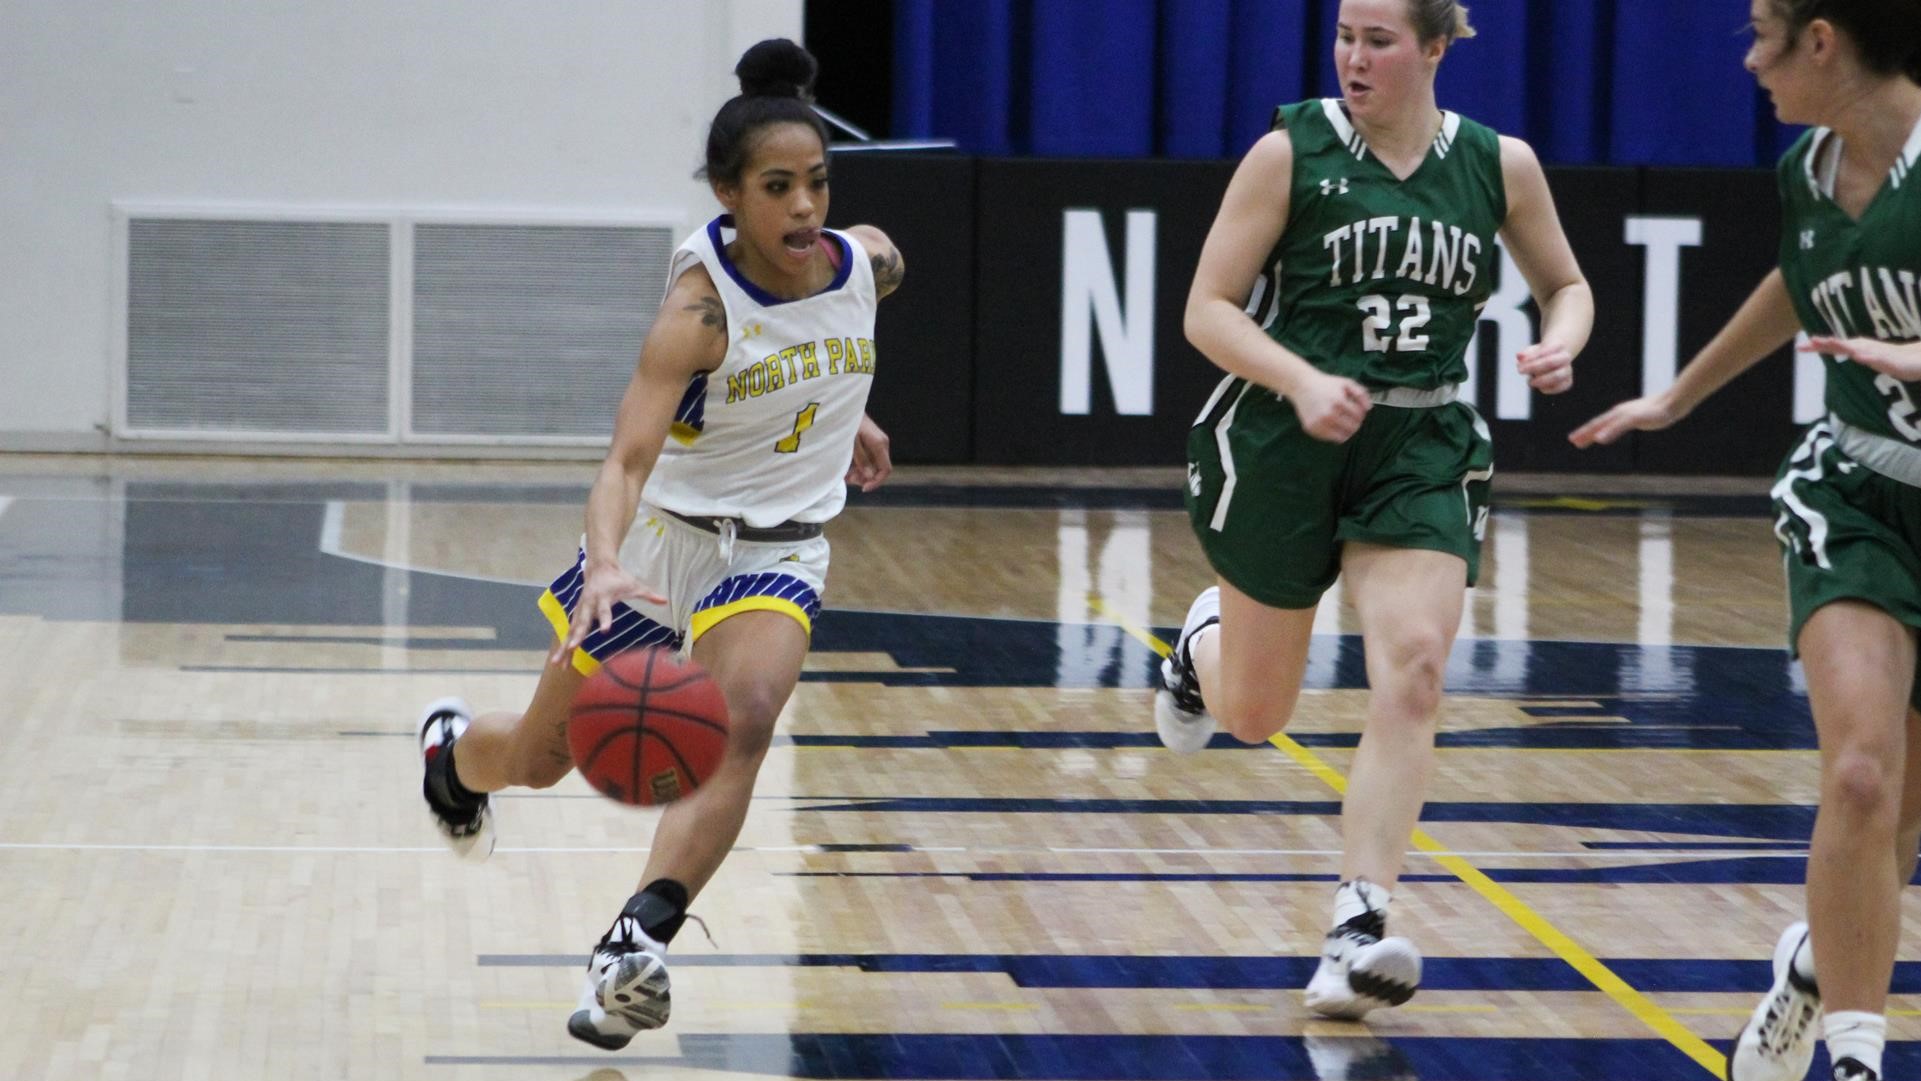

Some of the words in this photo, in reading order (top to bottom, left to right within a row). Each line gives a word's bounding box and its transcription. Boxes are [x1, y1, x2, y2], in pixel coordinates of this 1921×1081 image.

[1323, 215, 1482, 296] TITANS
[1356, 294, 1432, 353] 22
[725, 341, 821, 404] NORTH
[774, 402, 820, 453] 1
